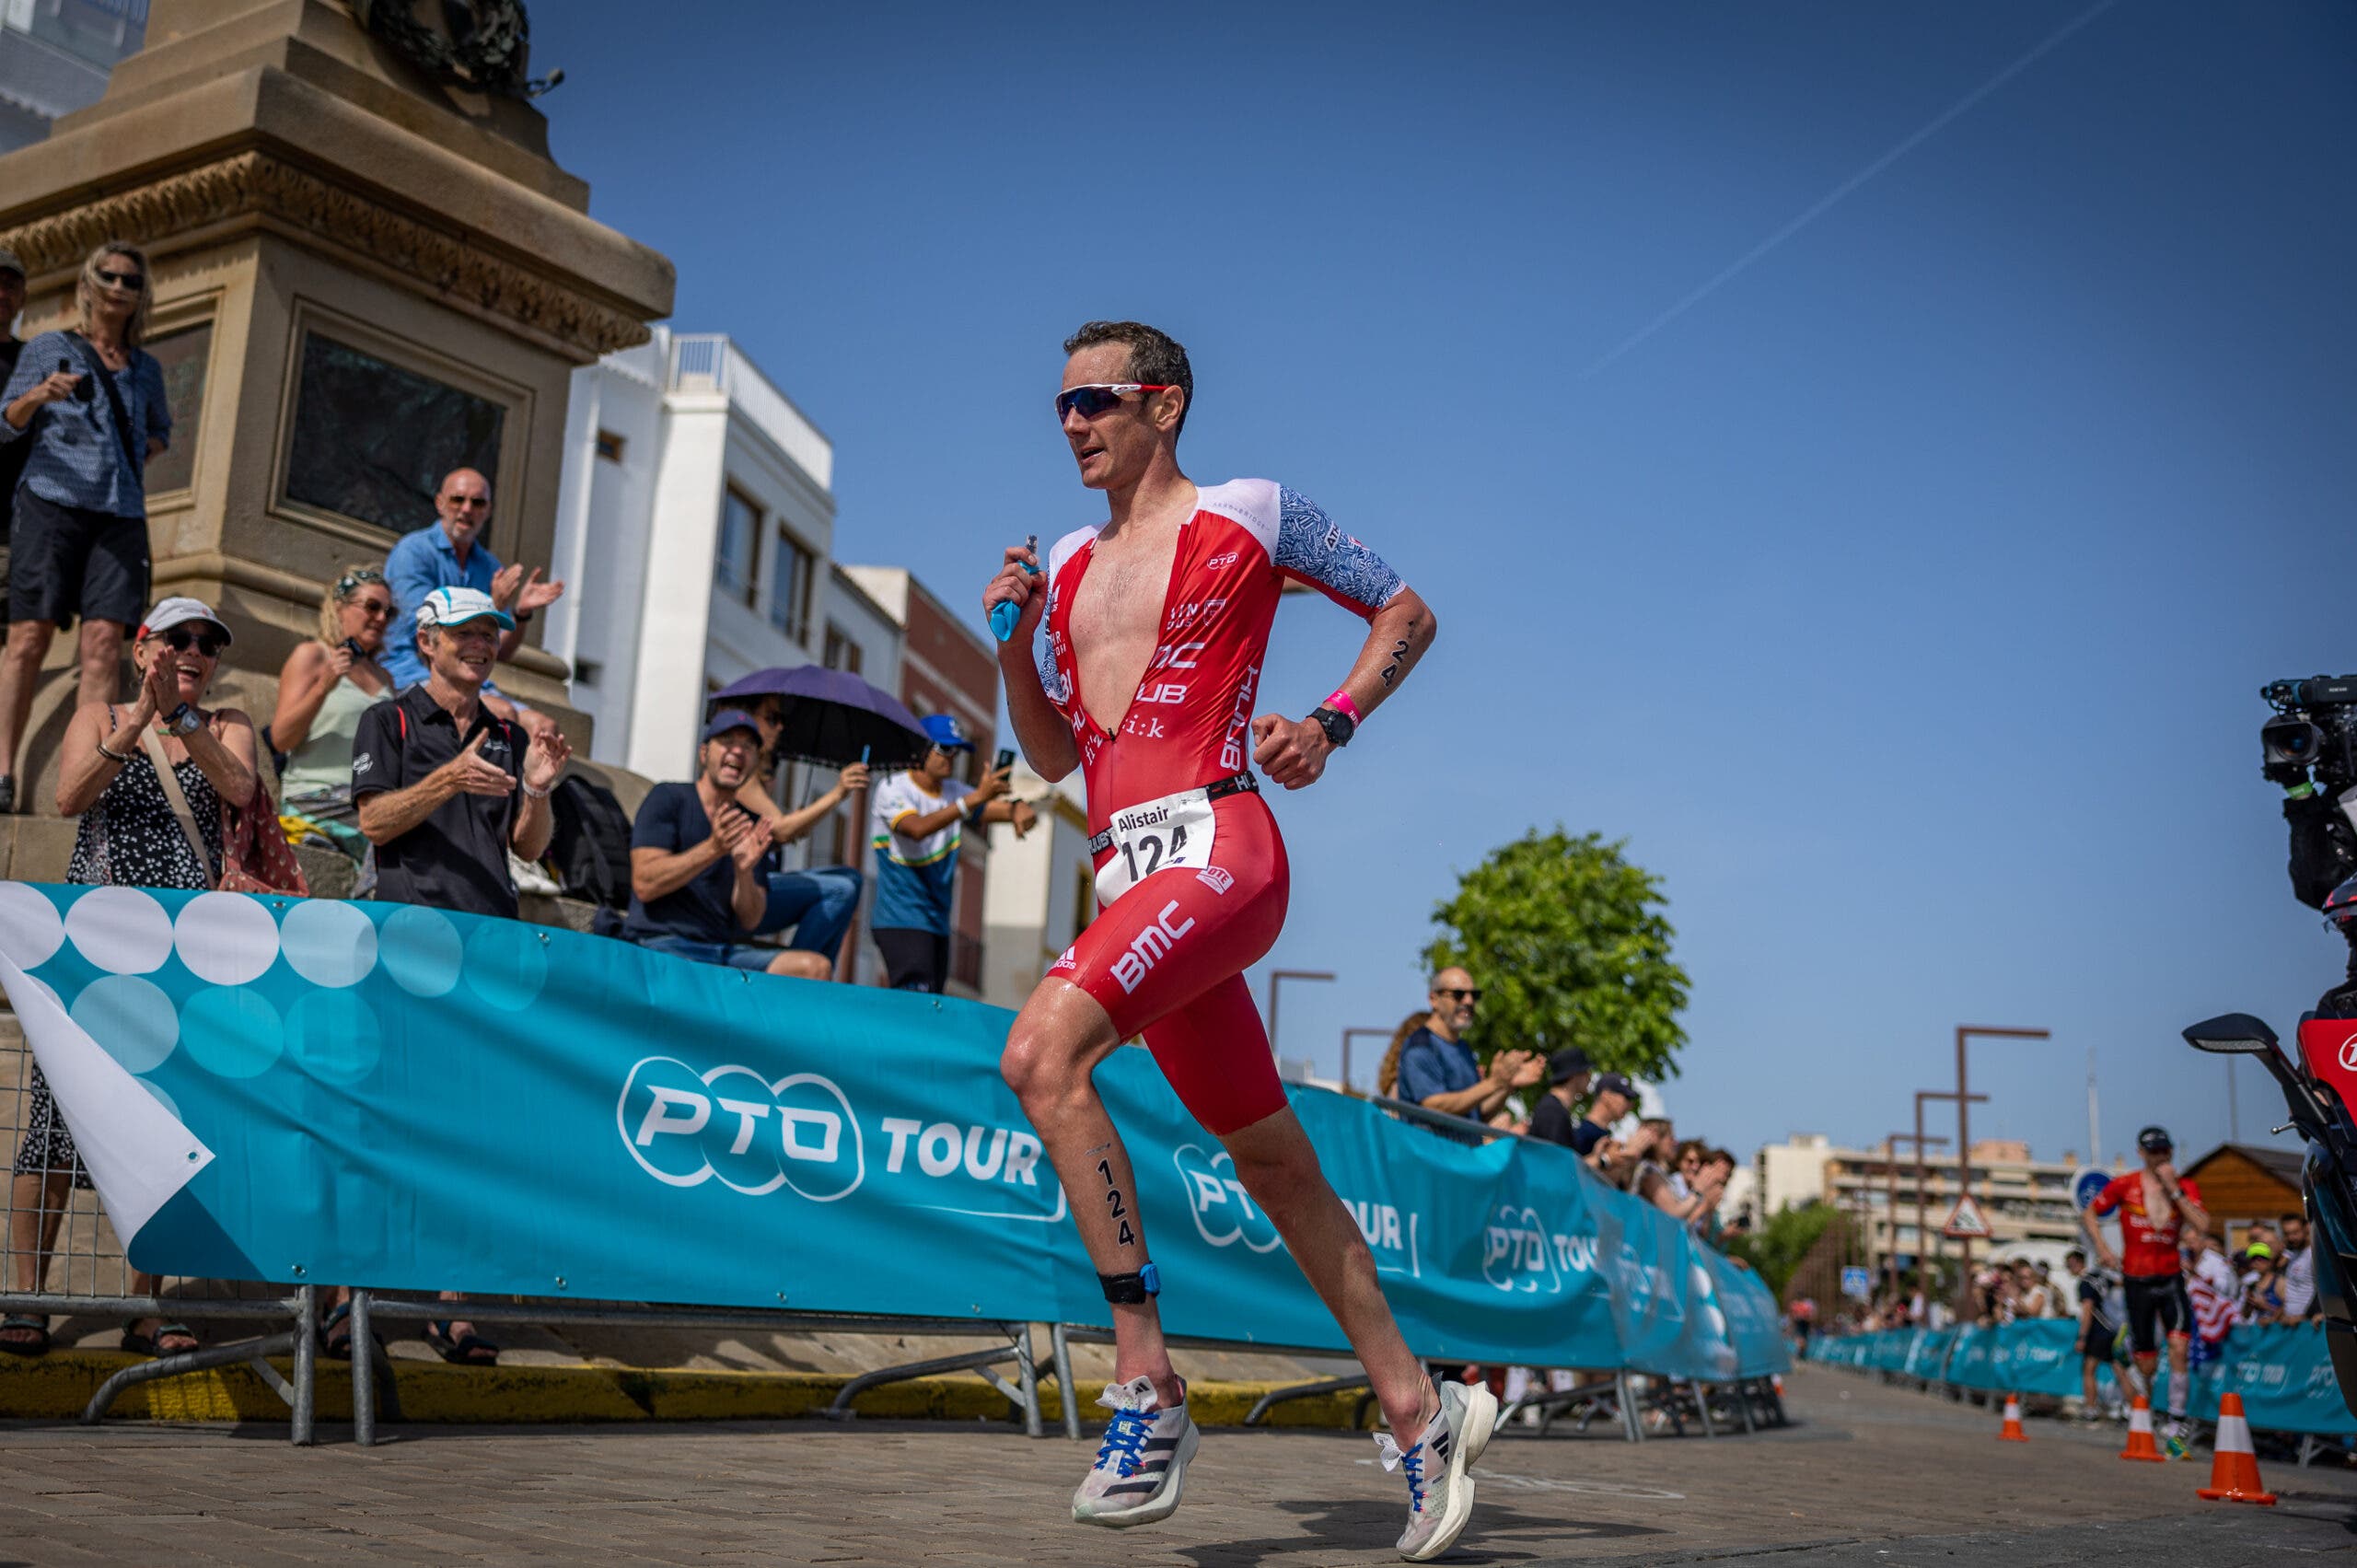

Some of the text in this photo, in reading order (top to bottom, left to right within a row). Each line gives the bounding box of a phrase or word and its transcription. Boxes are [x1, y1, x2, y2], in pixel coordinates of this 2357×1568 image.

[1209, 554, 1237, 567] PTO
[1118, 807, 1169, 832] Alistair
[1121, 825, 1188, 882] 124
[1109, 900, 1195, 994] BMC
[635, 1085, 1042, 1186] PTO TOUR
[1097, 1158, 1135, 1246] 124
[1188, 1169, 1403, 1250] PT UR
[1487, 1226, 1599, 1272] PTO TOU
